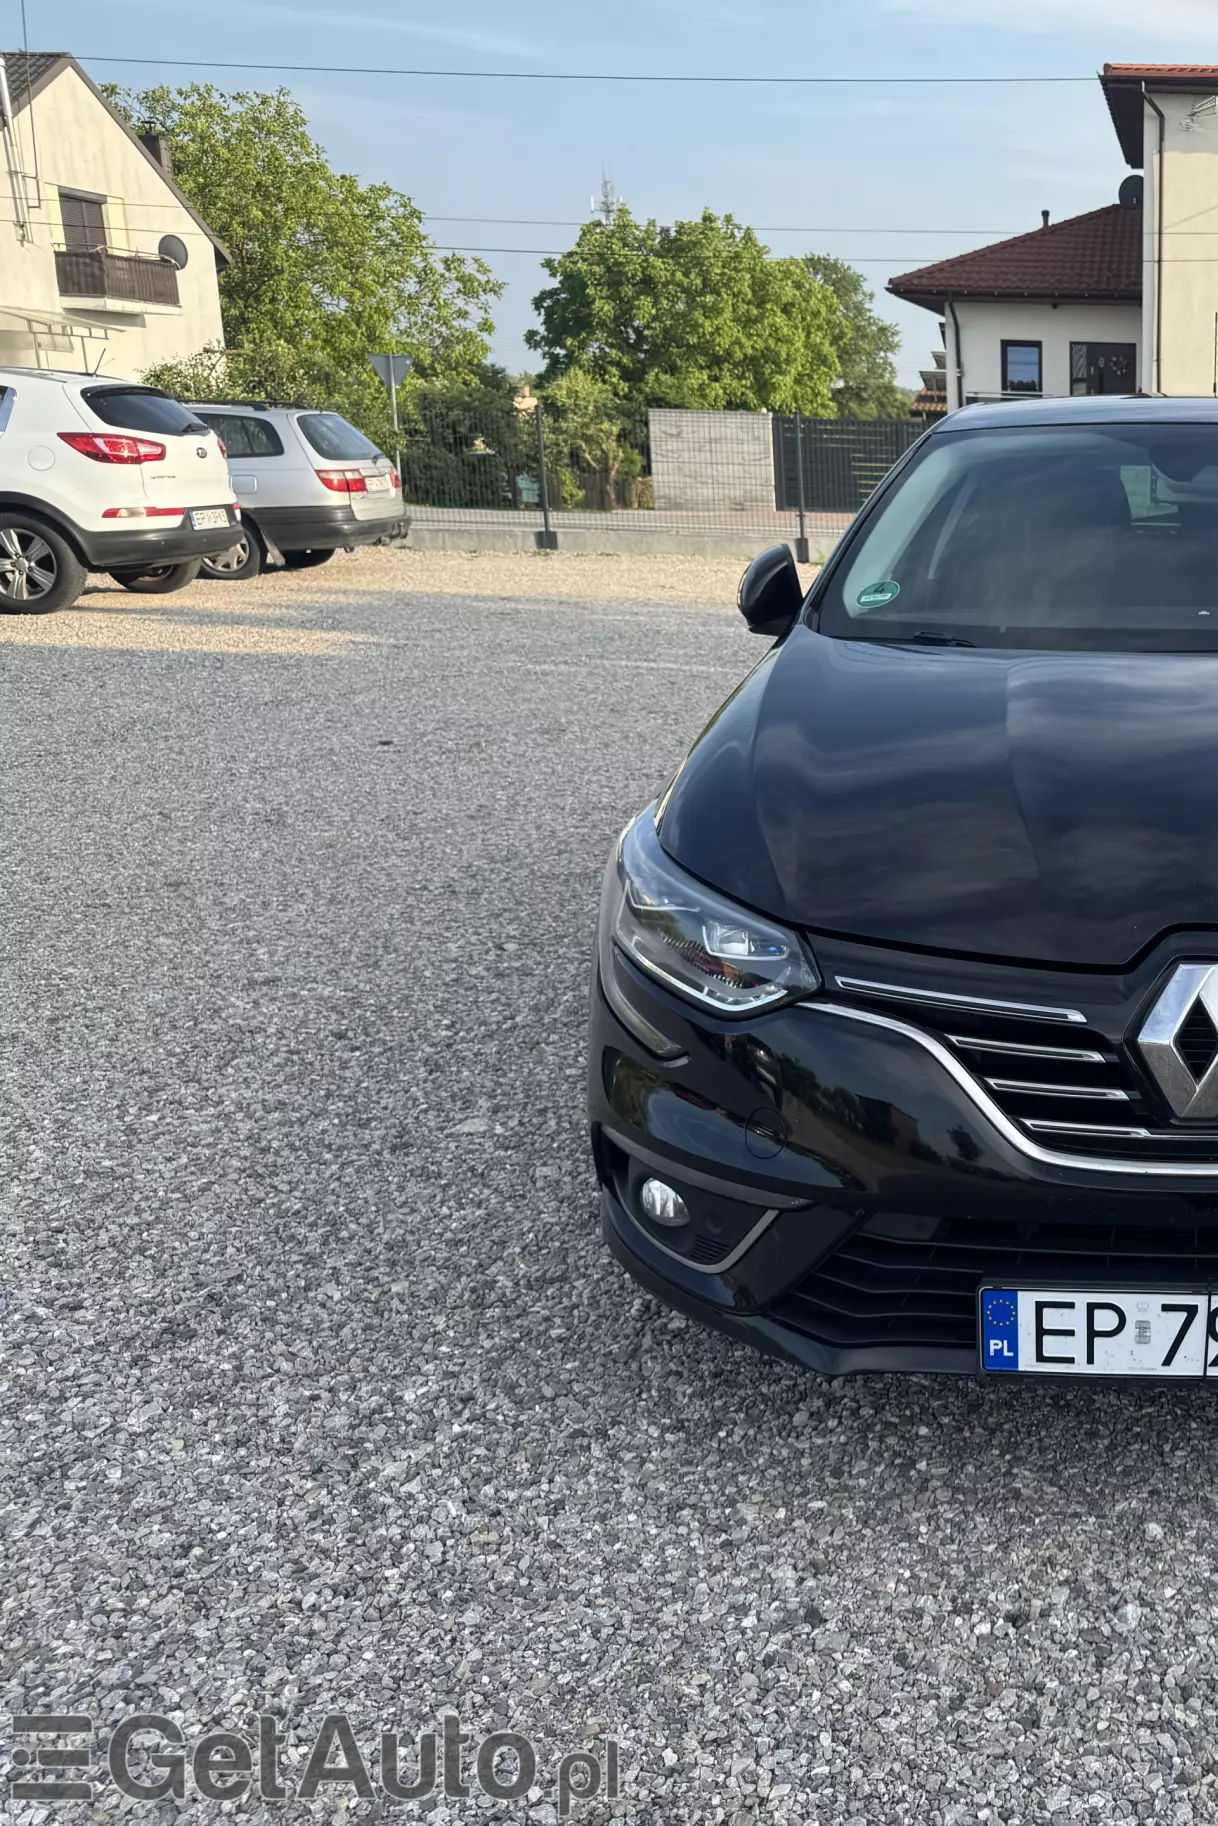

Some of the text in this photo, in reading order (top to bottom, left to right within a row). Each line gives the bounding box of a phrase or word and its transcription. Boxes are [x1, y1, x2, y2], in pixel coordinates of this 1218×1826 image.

[873, 582, 887, 594] 4
[1035, 1301, 1127, 1365] EP
[988, 1339, 1014, 1357] PL
